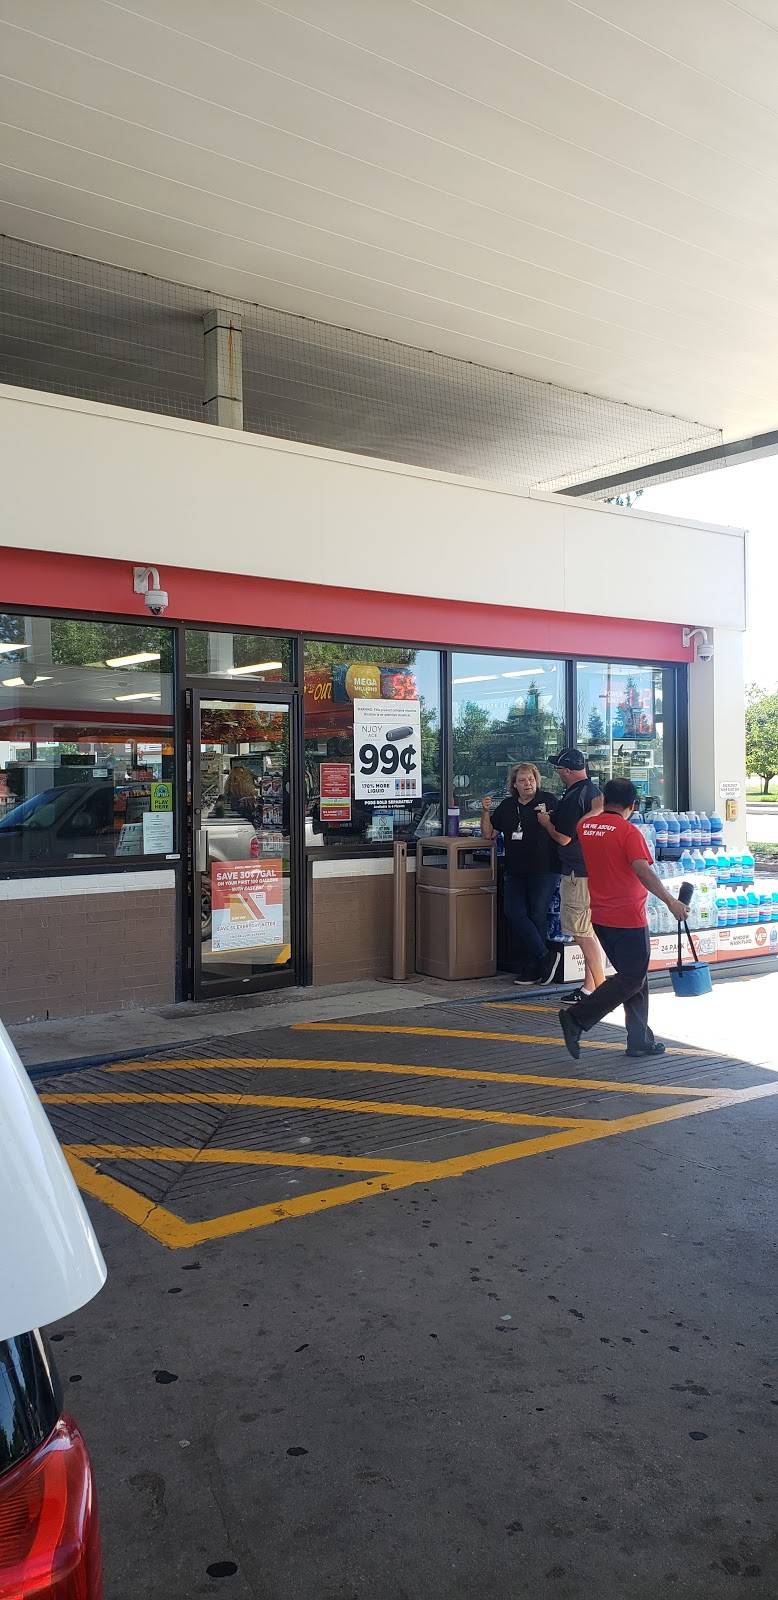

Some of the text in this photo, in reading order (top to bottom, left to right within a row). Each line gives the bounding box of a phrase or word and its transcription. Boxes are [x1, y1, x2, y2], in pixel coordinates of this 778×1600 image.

[353, 678, 377, 686] MEGA
[361, 725, 383, 733] NJOY
[359, 744, 417, 775] 99¢
[597, 824, 617, 832] ABOUT
[216, 871, 238, 881] SAVE
[669, 942, 685, 951] PAK
